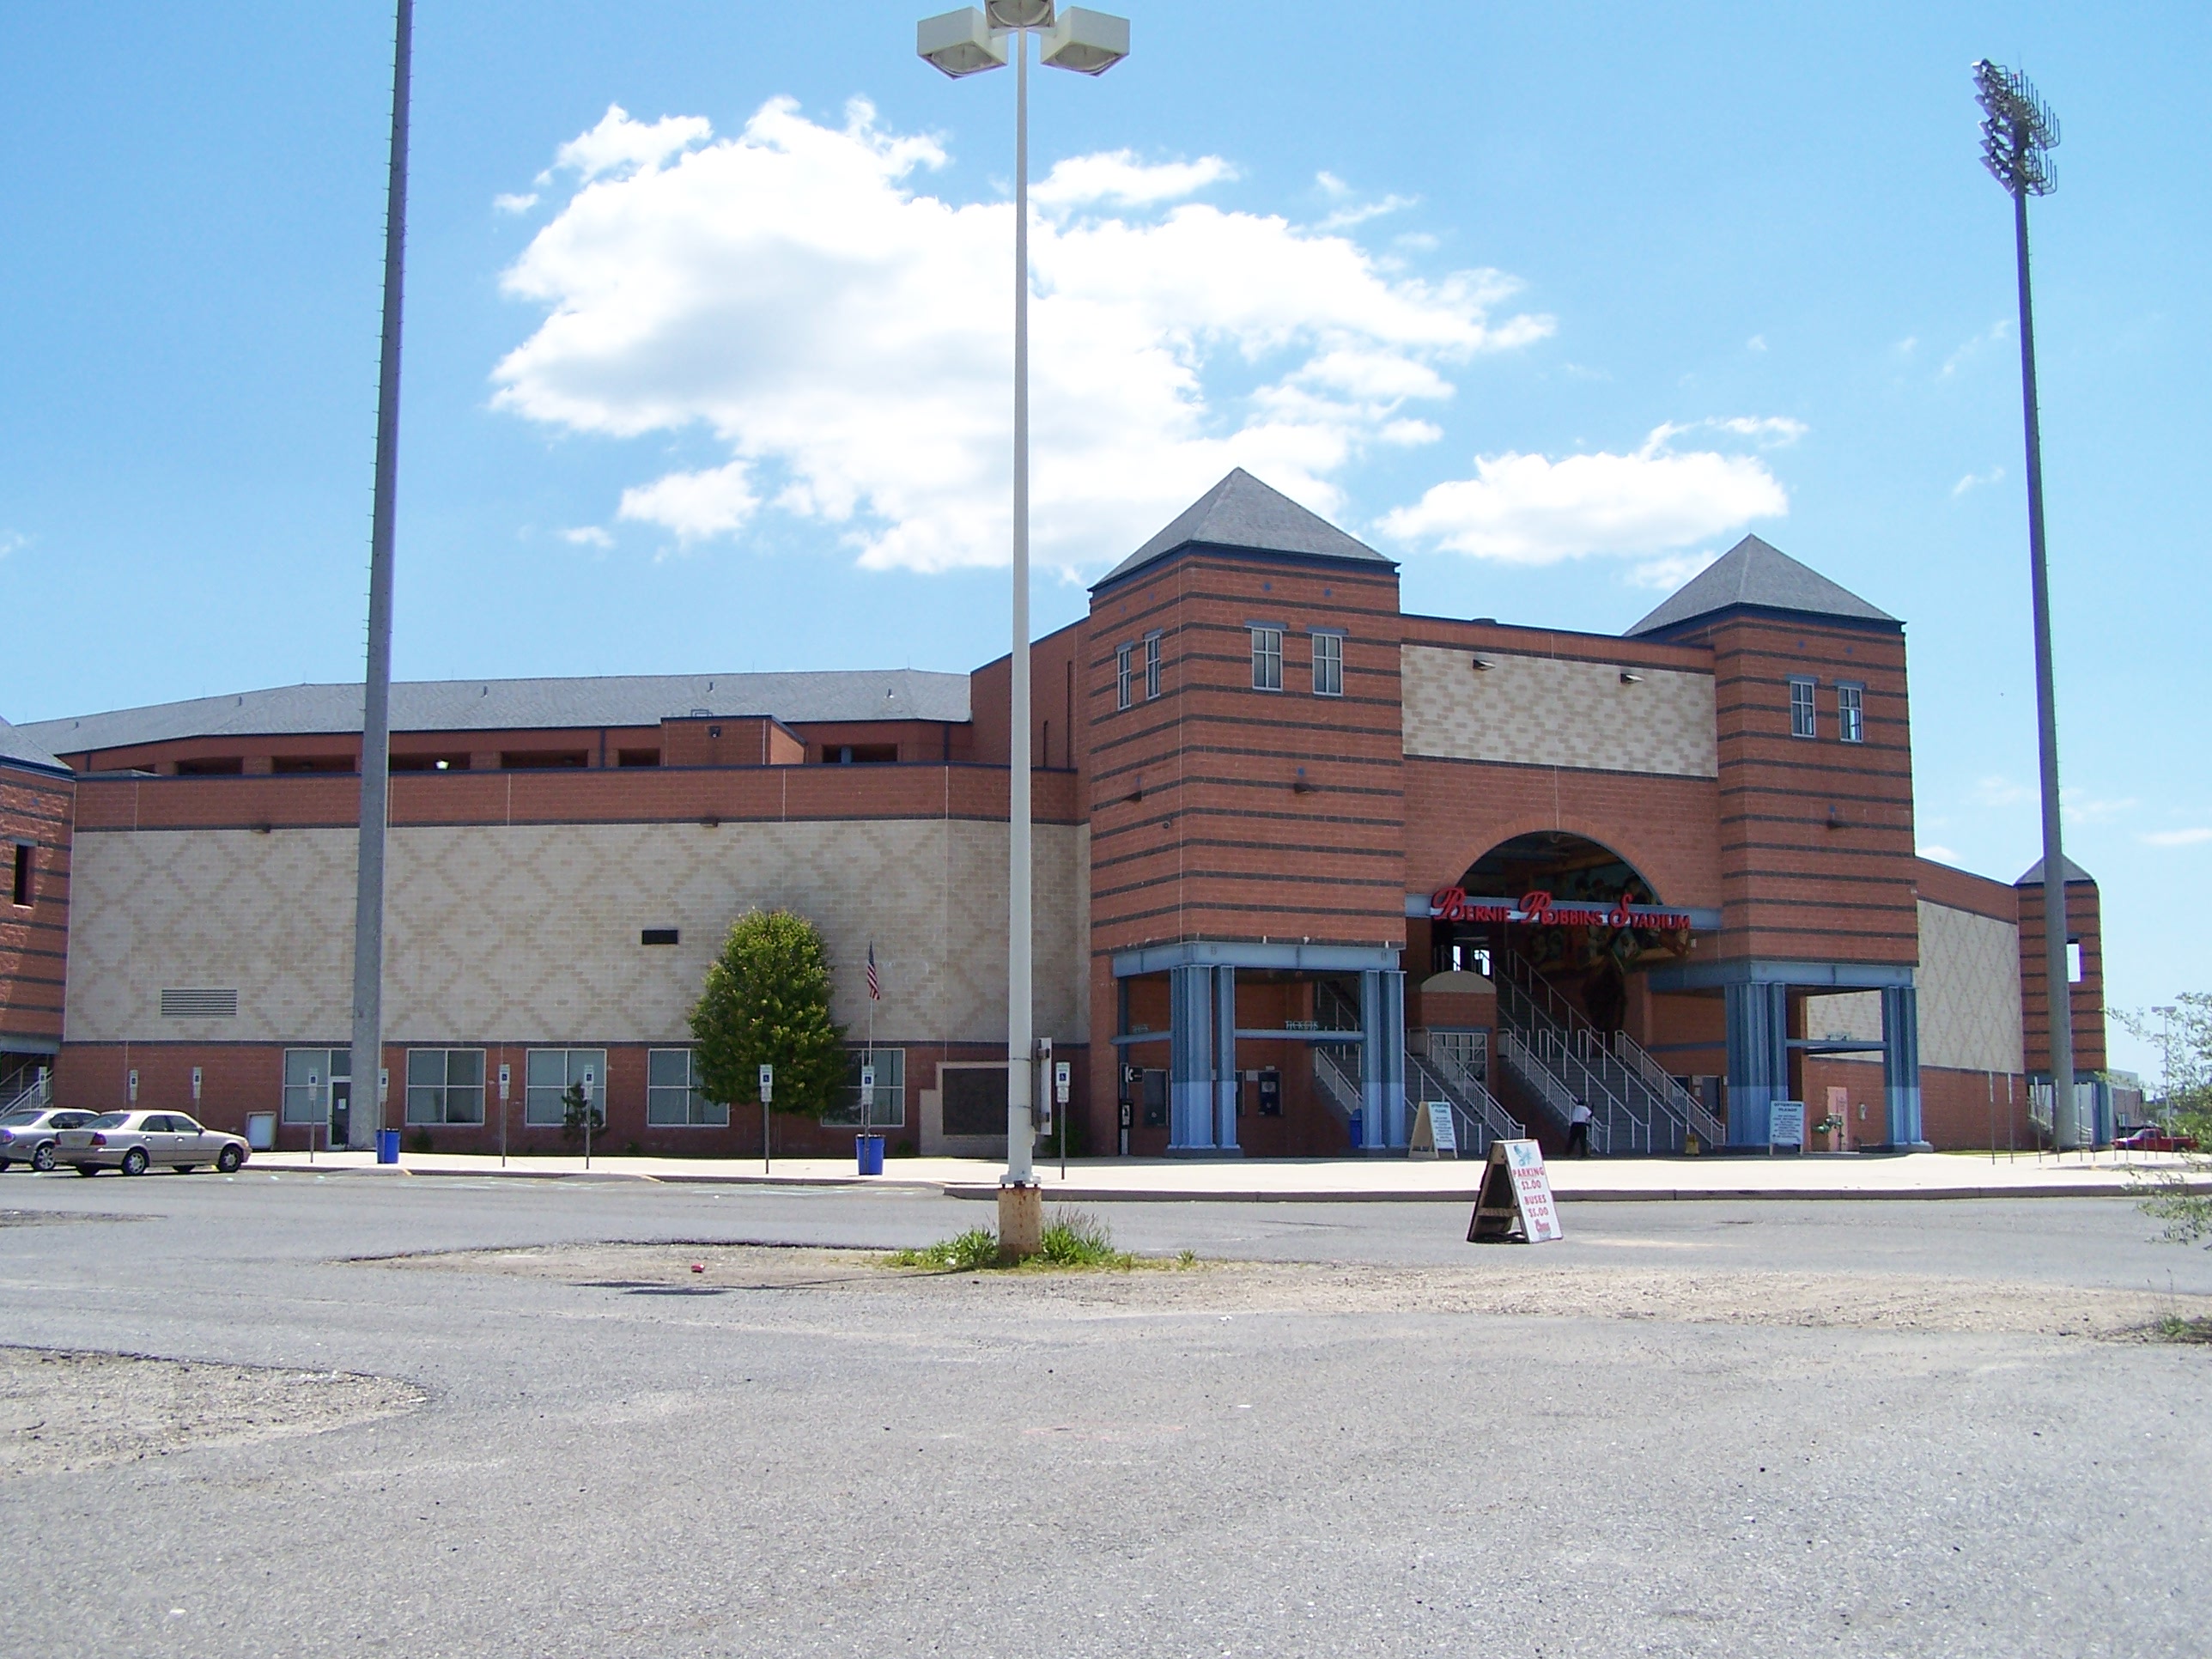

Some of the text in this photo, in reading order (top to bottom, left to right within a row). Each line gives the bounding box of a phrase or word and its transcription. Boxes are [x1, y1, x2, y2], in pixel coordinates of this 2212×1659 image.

[1431, 887, 1691, 928] BERNIE ROBBINS STADIUM
[1512, 1167, 1545, 1177] PARKING
[1522, 1180, 1541, 1190] $2.00
[1524, 1194, 1547, 1205] BUSES
